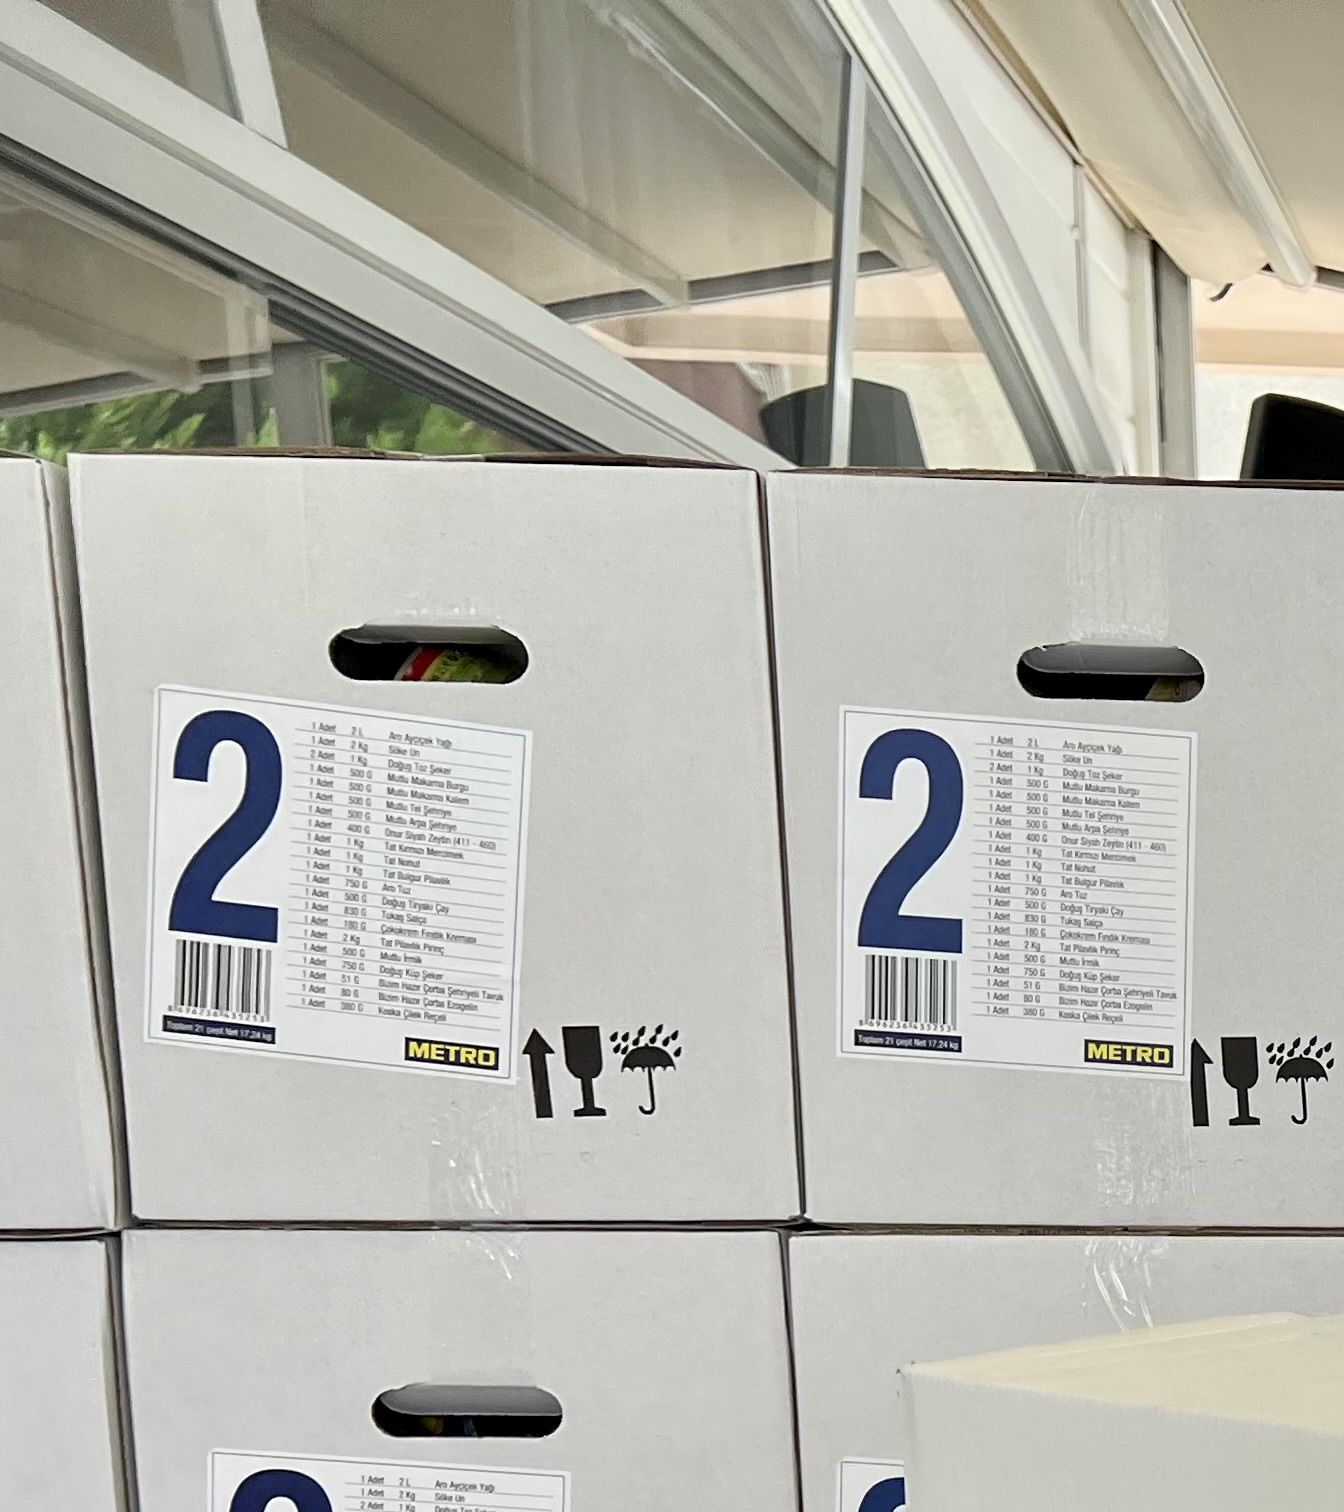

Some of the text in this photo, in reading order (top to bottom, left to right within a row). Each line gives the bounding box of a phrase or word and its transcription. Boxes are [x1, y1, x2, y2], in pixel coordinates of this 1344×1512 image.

[168, 710, 282, 943] 2
[858, 728, 964, 953] 2
[408, 1040, 495, 1066] METRO
[1087, 1042, 1170, 1064] METRO
